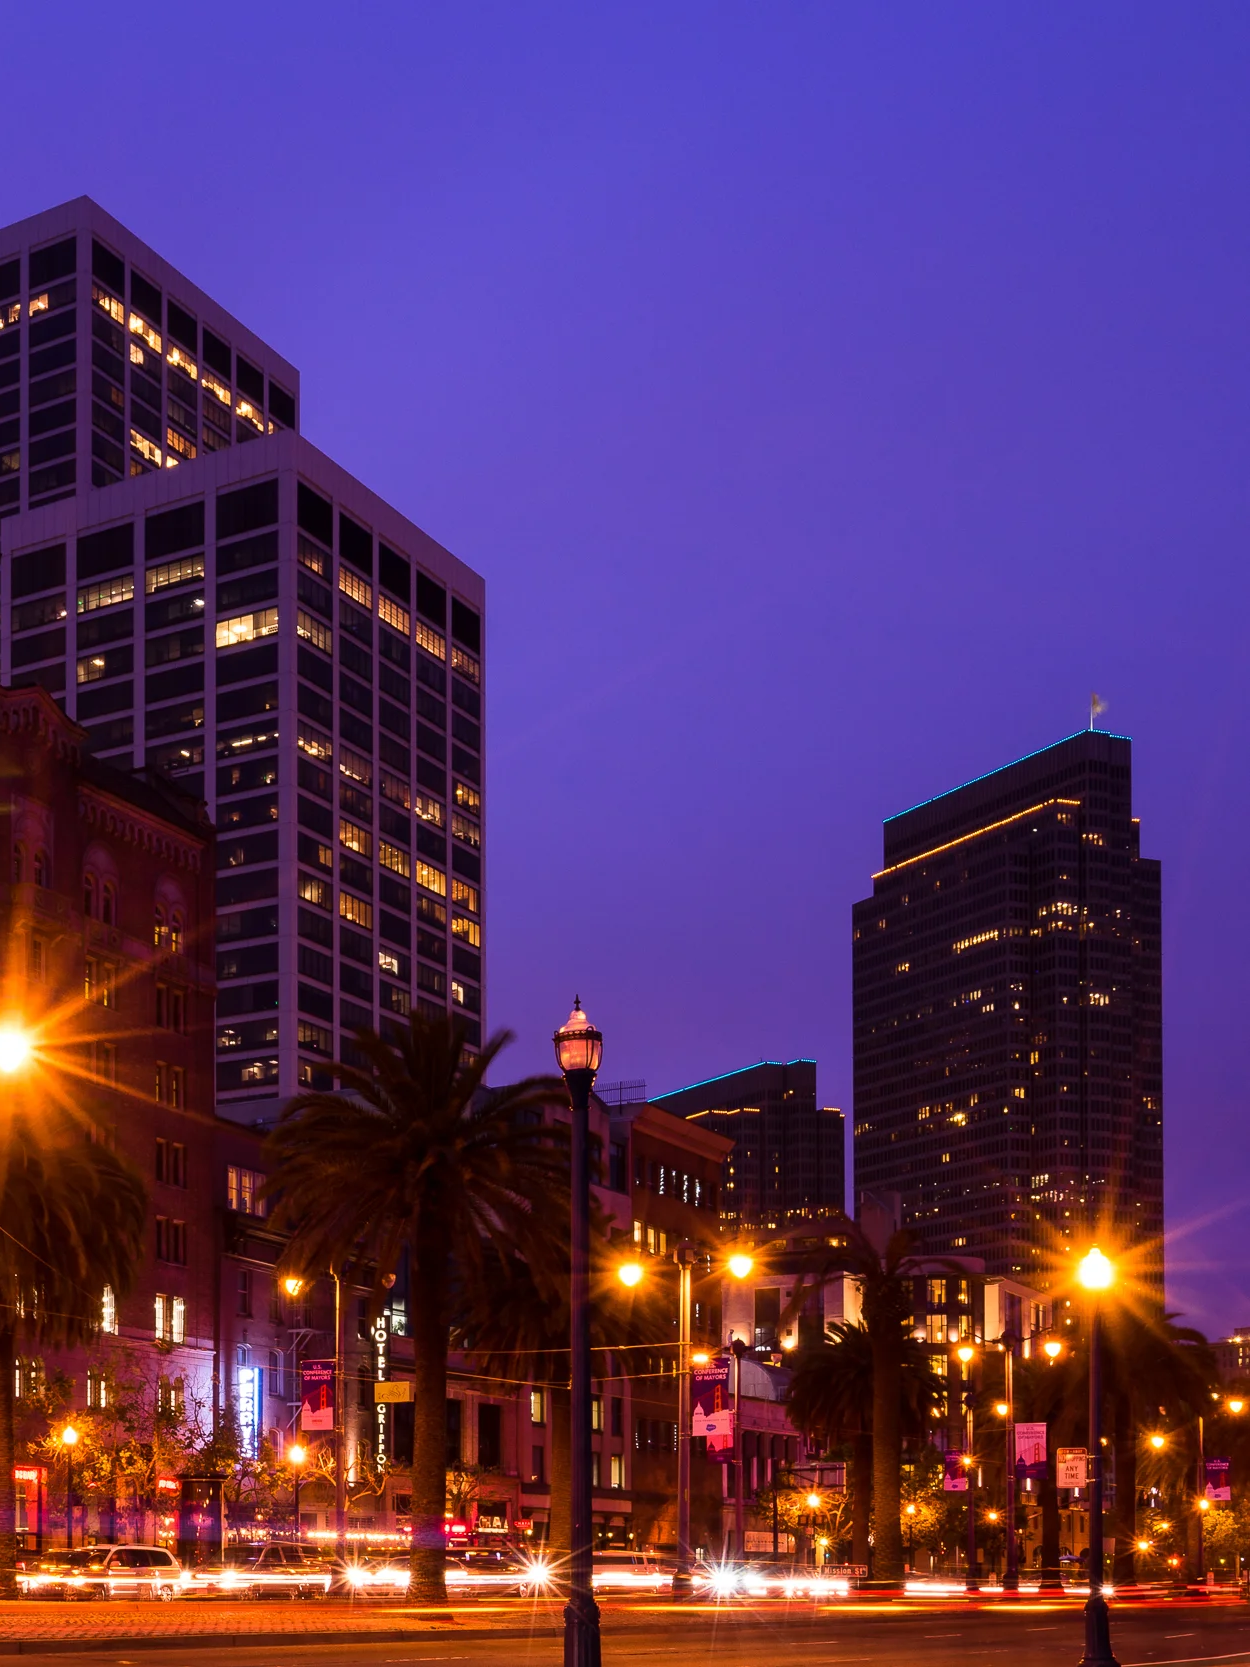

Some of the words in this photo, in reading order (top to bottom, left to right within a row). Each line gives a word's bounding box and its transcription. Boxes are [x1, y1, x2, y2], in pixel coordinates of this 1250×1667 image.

[375, 1316, 387, 1381] HOTEL
[693, 1367, 729, 1375] CONFERENCE
[376, 1403, 387, 1473] GRIFFON
[1064, 1472, 1080, 1480] TIME
[824, 1566, 852, 1575] Mission
[854, 1567, 863, 1575] St
